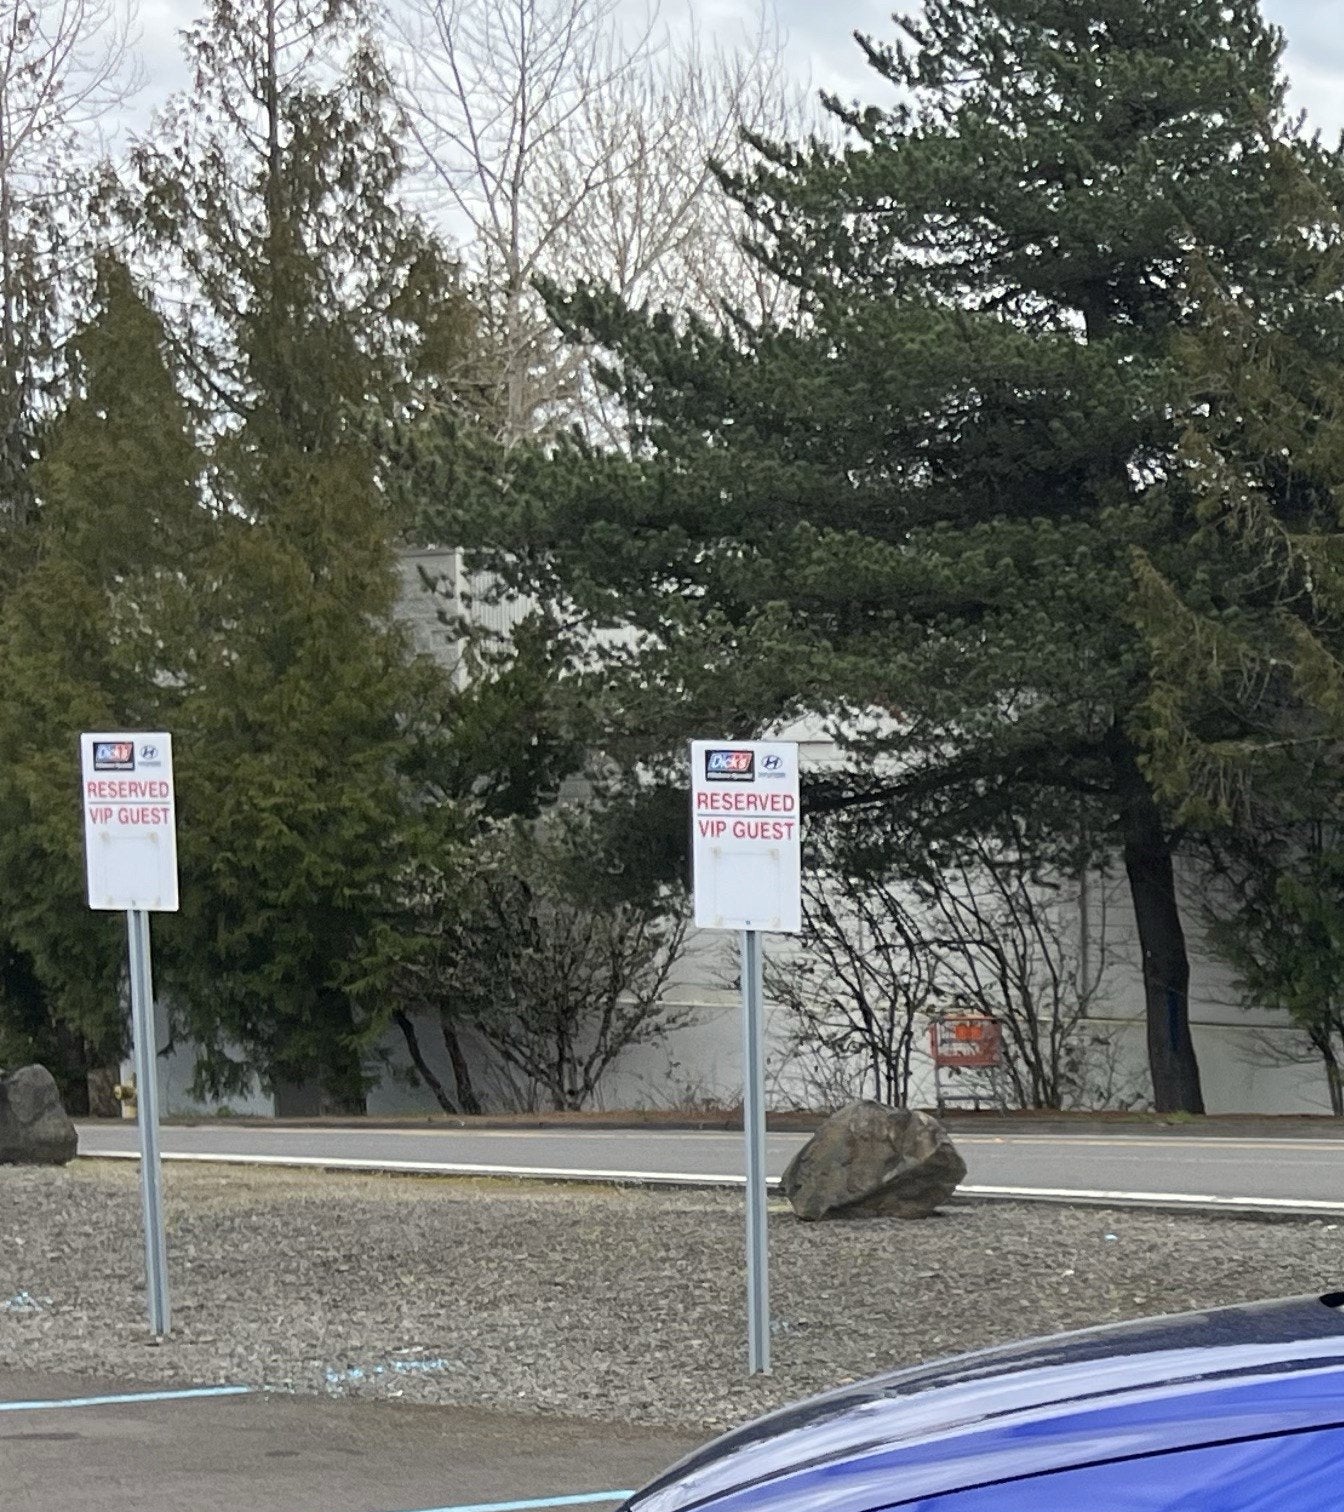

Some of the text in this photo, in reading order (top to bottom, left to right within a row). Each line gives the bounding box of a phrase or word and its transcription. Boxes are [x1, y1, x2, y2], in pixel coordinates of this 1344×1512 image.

[87, 781, 169, 798] RESERVED
[697, 792, 795, 812] RESERVED
[89, 807, 170, 825] VIP GUEST
[699, 820, 795, 840] VIP GUEST
